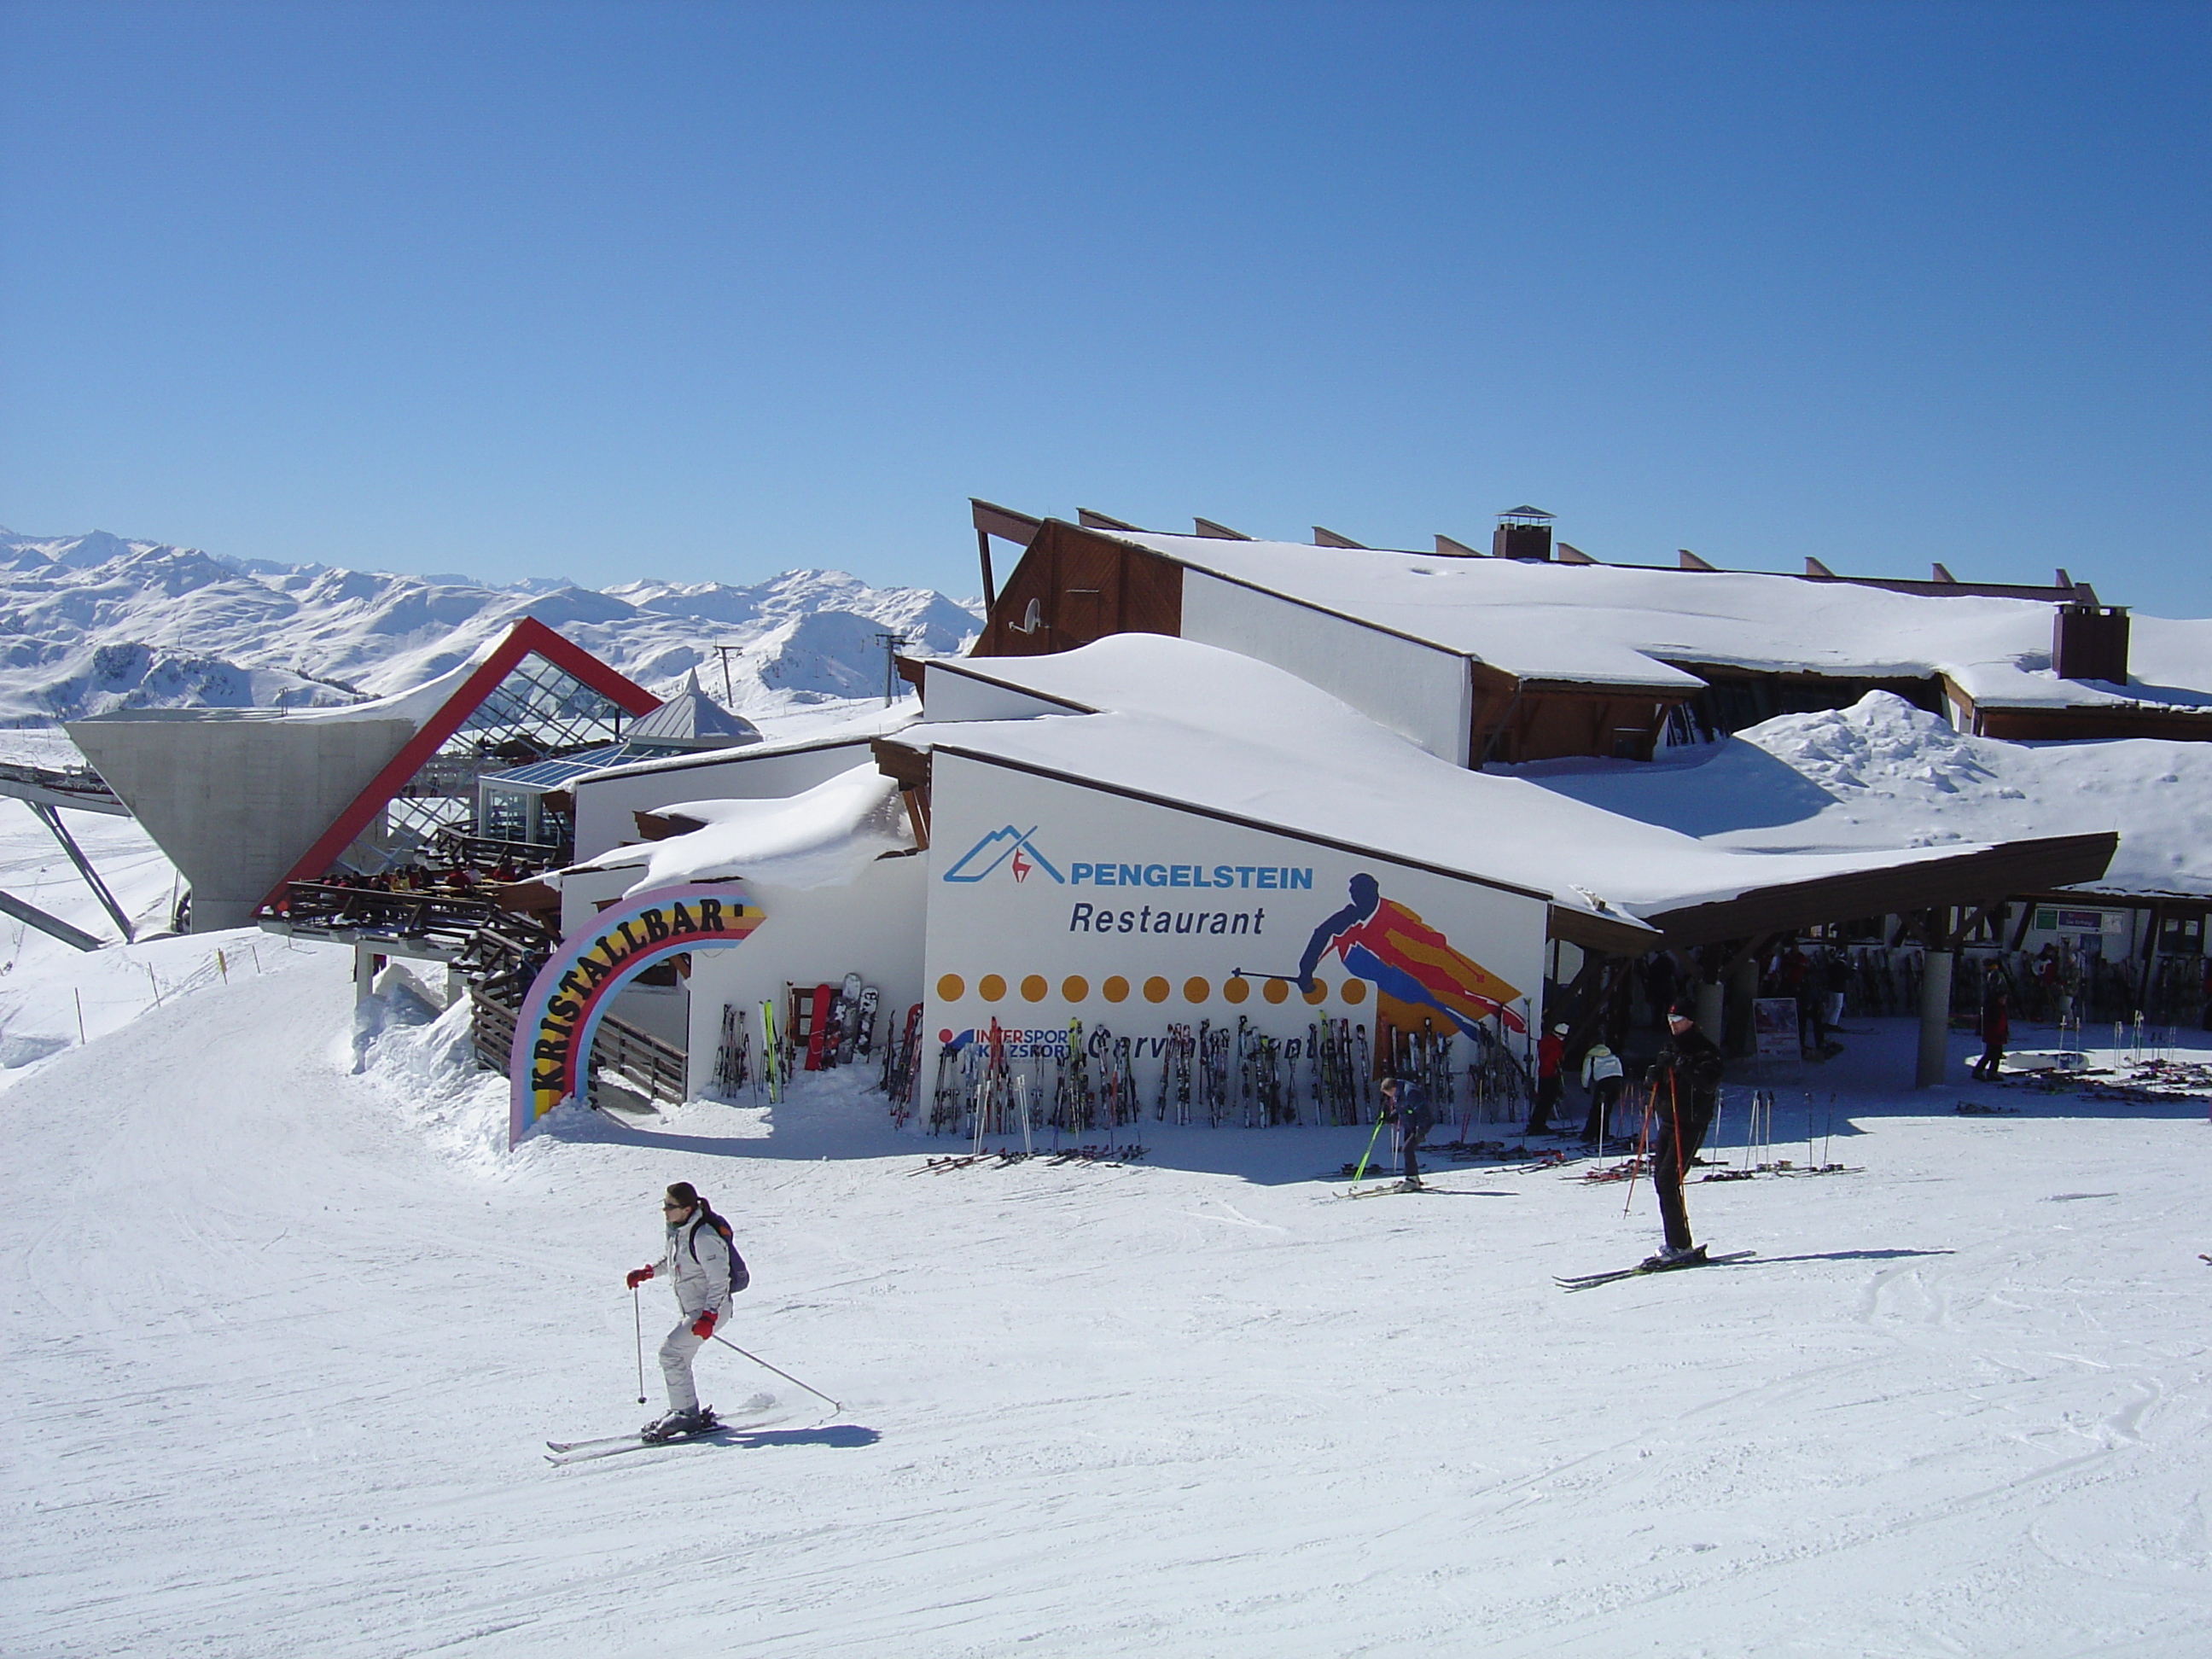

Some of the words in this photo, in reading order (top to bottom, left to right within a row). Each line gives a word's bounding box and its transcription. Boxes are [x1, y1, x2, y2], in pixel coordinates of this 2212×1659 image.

[1071, 863, 1313, 889] PENGELSTEIN
[1069, 903, 1265, 934] Restaurant
[532, 899, 725, 1091] KRISTALLBAR
[975, 1029, 1078, 1044] INERSPOR
